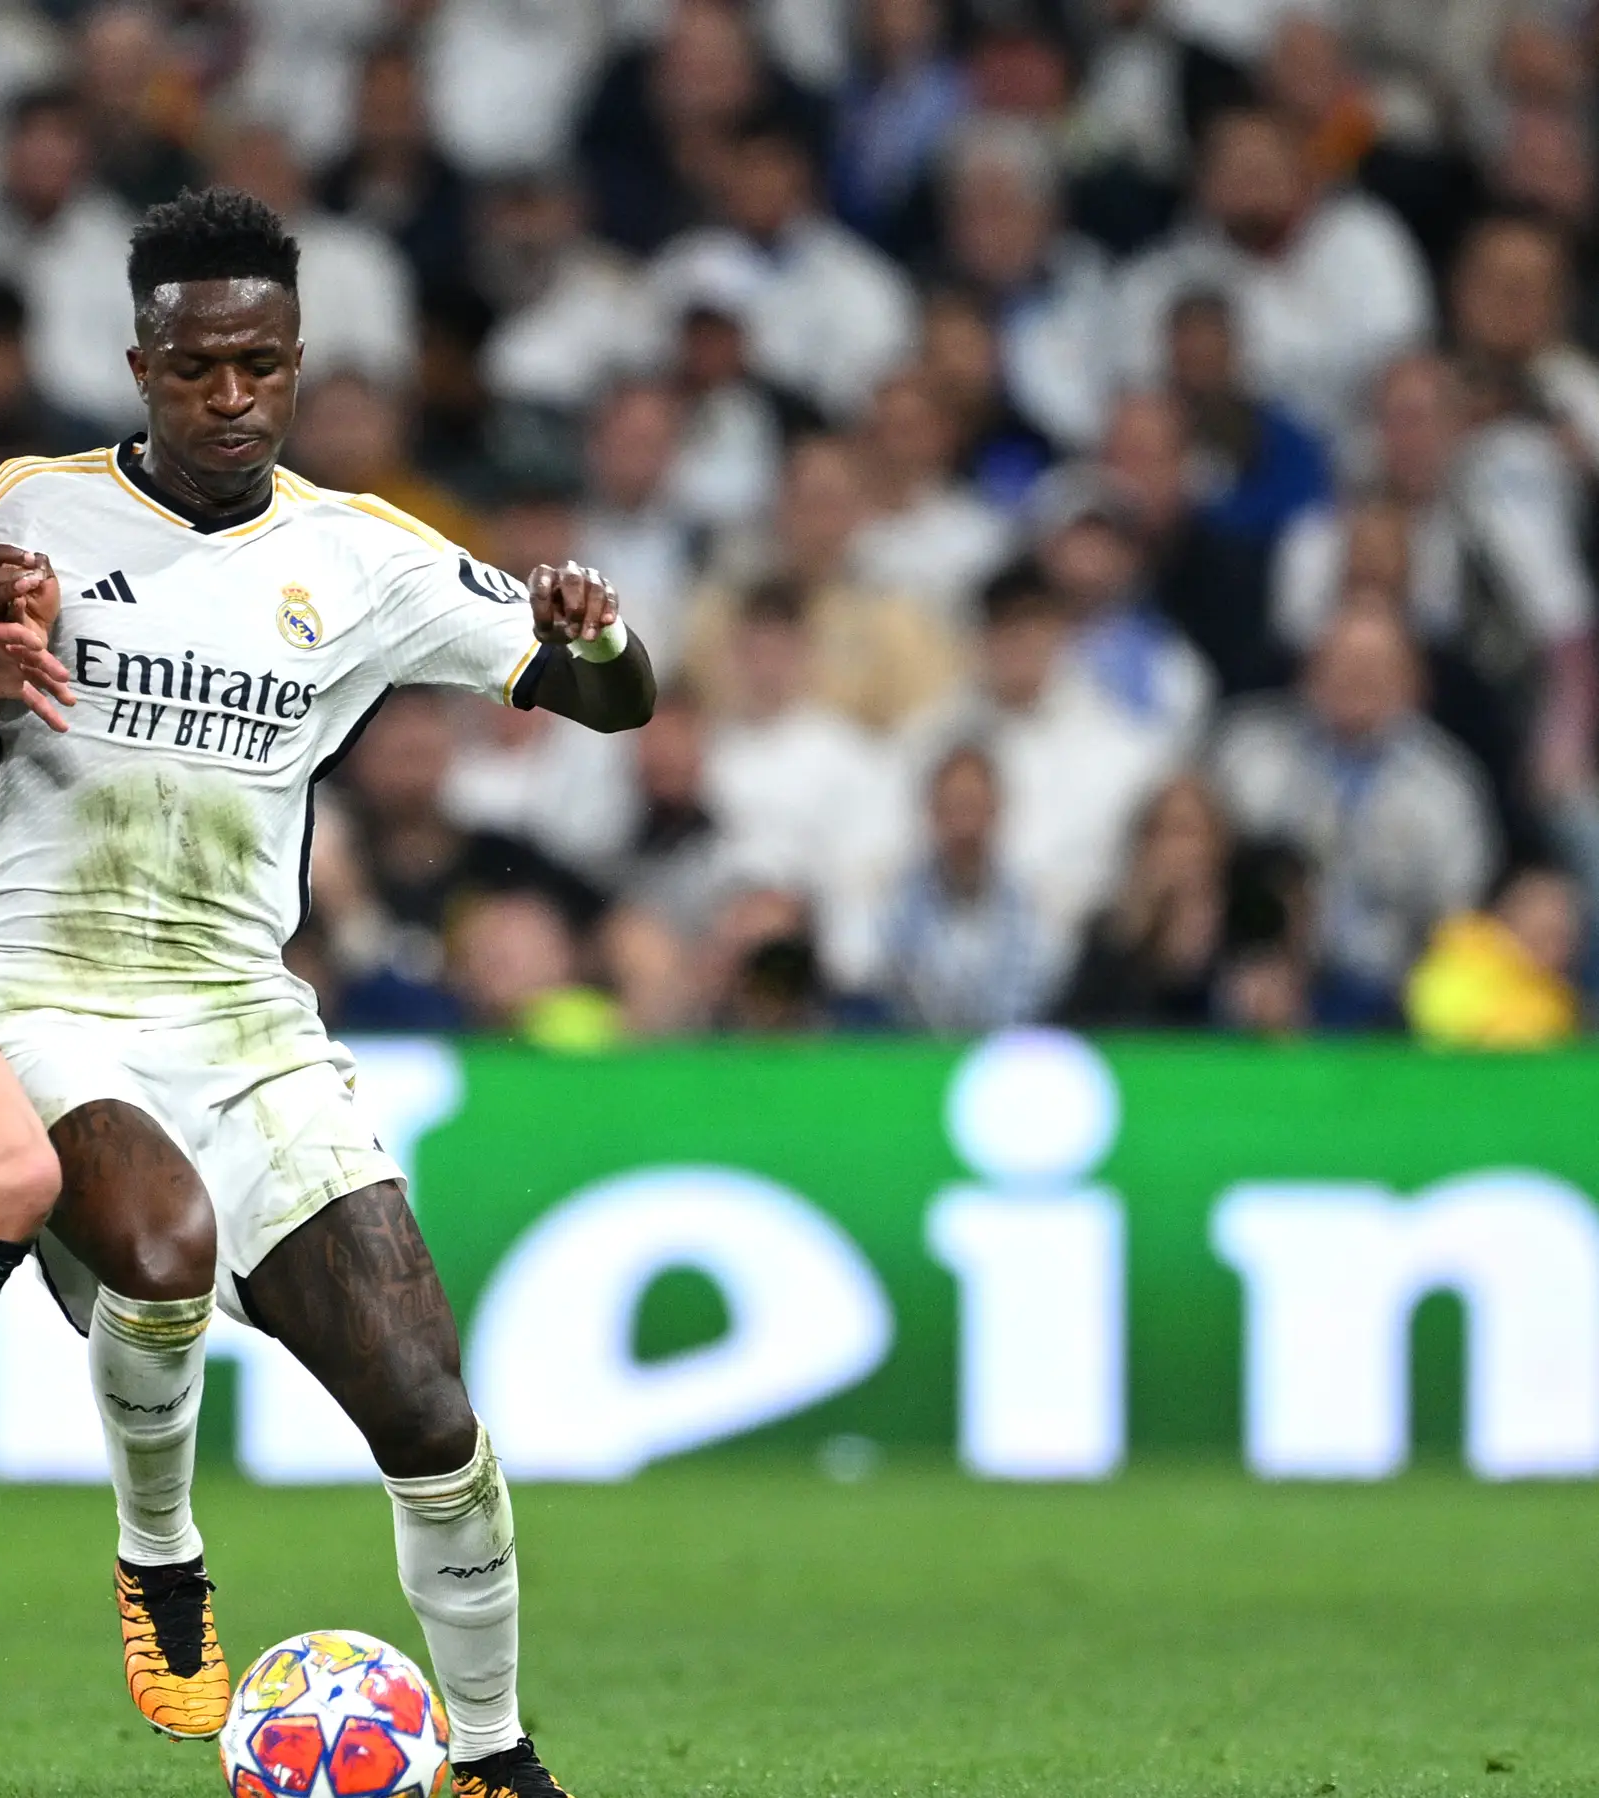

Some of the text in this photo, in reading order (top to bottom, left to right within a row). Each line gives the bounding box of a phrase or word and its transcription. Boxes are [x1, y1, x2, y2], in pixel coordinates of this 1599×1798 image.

[74, 637, 317, 720] Emirates
[107, 698, 280, 763] FLY BETTER
